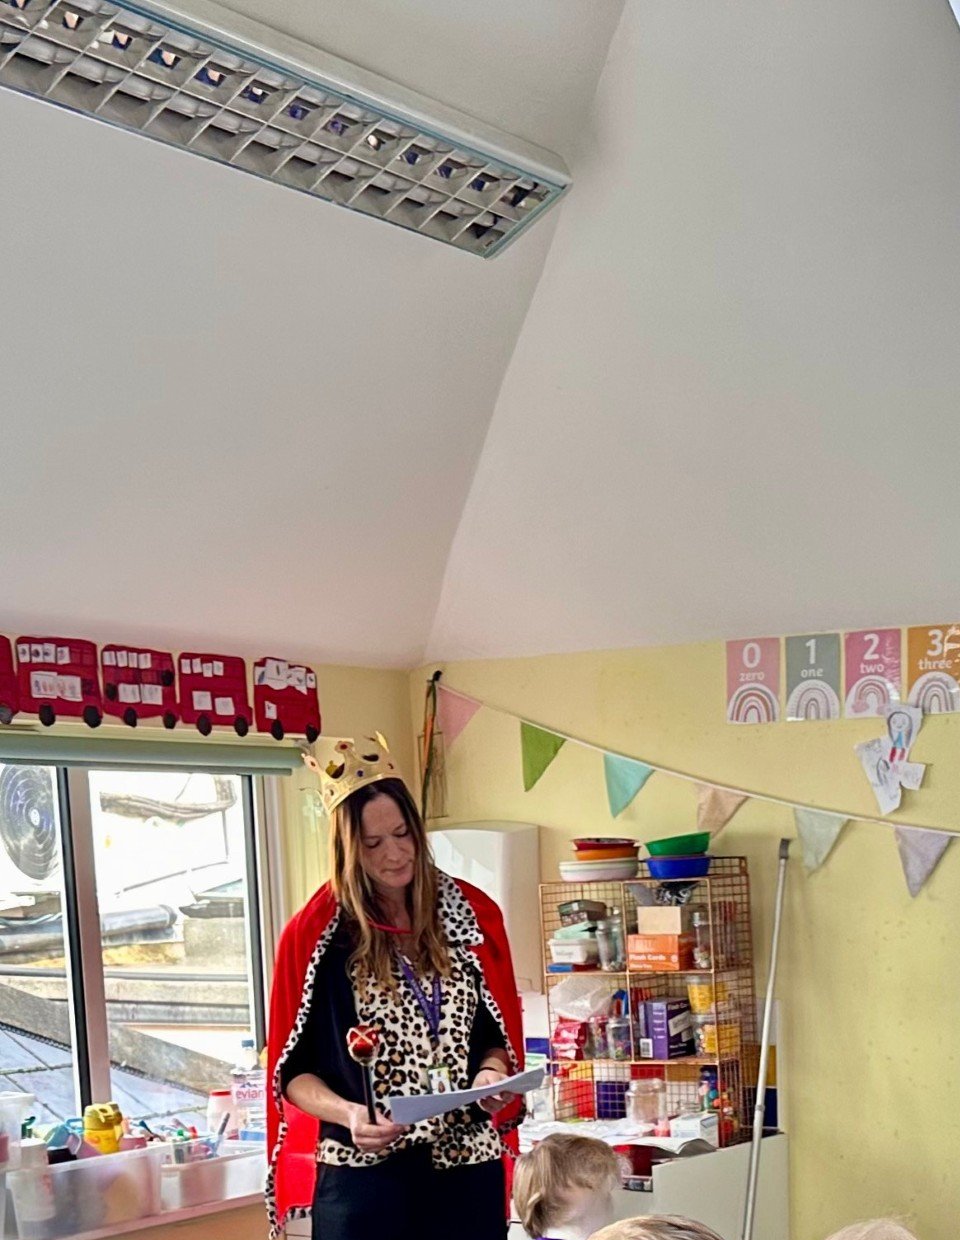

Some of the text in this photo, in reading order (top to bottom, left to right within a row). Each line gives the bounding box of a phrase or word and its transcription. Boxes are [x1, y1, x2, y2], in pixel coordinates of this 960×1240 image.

[863, 633, 880, 660] 2
[926, 628, 943, 656] 3
[742, 642, 761, 668] 0
[805, 638, 816, 664] 1
[860, 663, 884, 673] two
[918, 657, 952, 670] three
[739, 671, 765, 681] zero
[800, 667, 823, 678] one
[236, 1089, 265, 1099] evian
